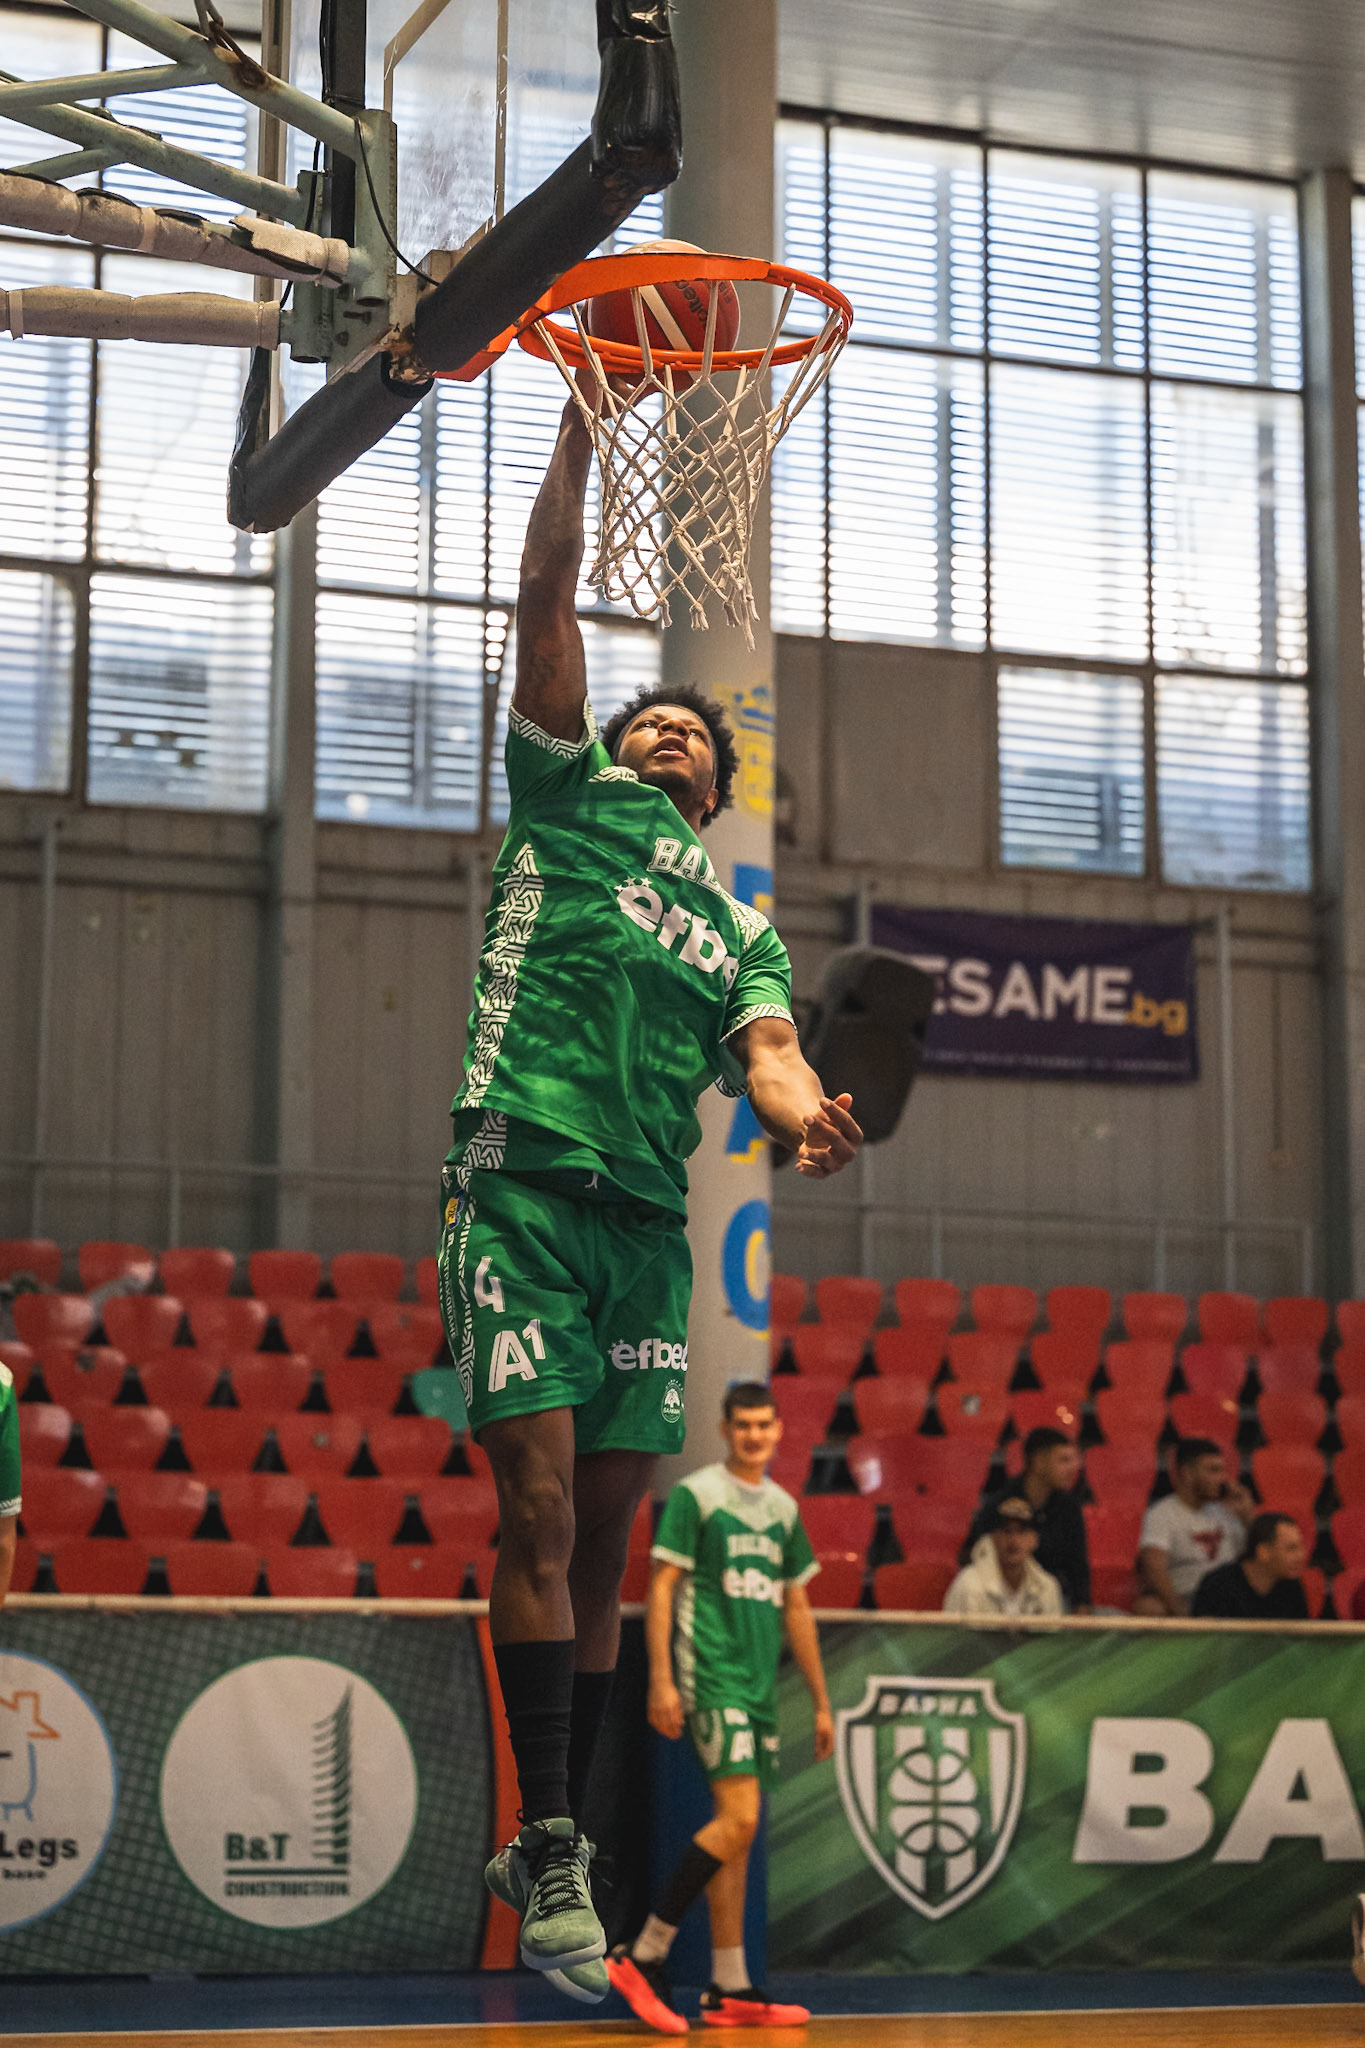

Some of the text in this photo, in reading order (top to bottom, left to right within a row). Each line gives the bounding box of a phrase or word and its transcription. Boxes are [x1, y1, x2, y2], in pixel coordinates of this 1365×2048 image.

[474, 1256, 506, 1313] 4
[488, 1319, 546, 1392] A1
[0, 1831, 79, 1867] Legs
[225, 1832, 290, 1860] B&T
